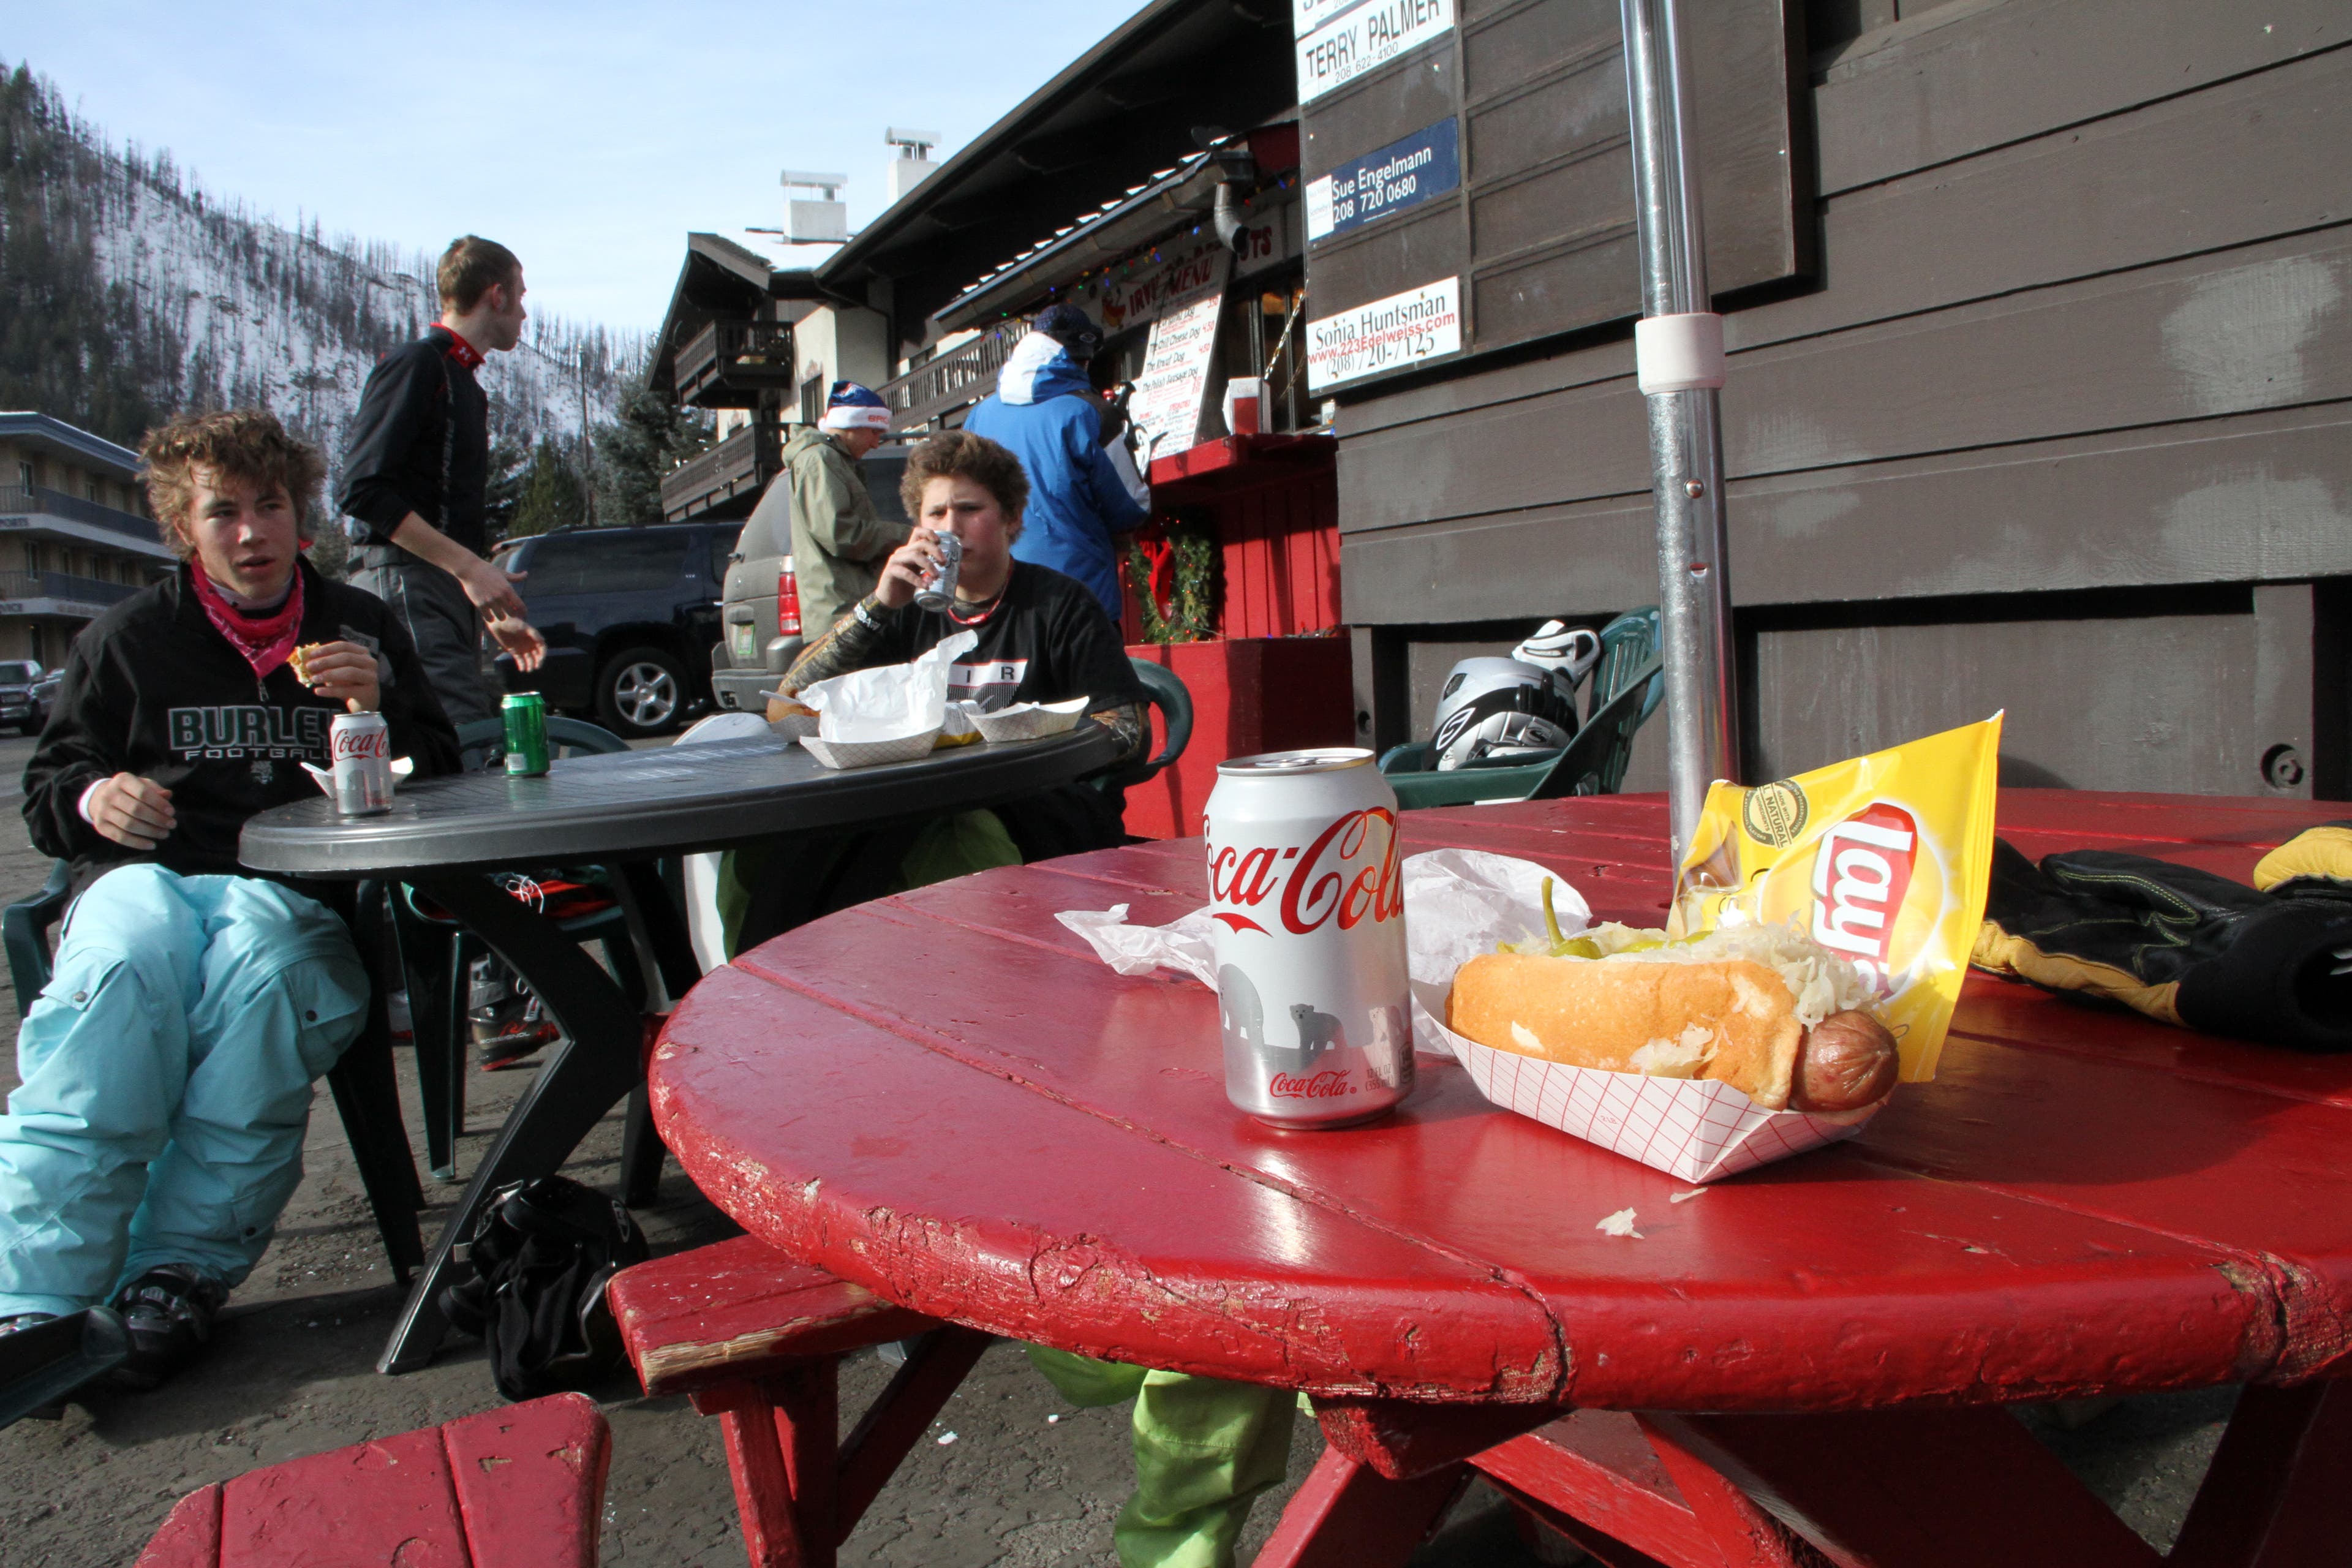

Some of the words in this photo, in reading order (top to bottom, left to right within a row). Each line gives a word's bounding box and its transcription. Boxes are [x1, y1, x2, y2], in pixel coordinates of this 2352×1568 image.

[1306, 26, 1357, 78] TERRY
[1368, 0, 1439, 51] PALMER
[1335, 66, 1351, 83] 208
[1355, 42, 1398, 73] 622-4100
[1332, 180, 1354, 202] Sue
[1358, 147, 1431, 190] Engelmann
[1333, 200, 1354, 224] 208
[1360, 189, 1384, 213] 720
[1387, 175, 1416, 206] 0680
[1189, 327, 1200, 339] Dog
[1308, 312, 1456, 365] www.223Edelweiss.com
[1316, 317, 1355, 350] Sonia
[1360, 295, 1446, 336] Huntsman
[1173, 352, 1185, 363] Dog
[1188, 367, 1199, 379] Dog
[1327, 352, 1355, 379] (208)
[167, 705, 340, 750] BURLE
[334, 728, 390, 761] Coca-C
[1755, 794, 1770, 832] INGREDIENTS
[1765, 796, 1789, 848] NATURAL
[1270, 1069, 1352, 1099] Coca-Cola
